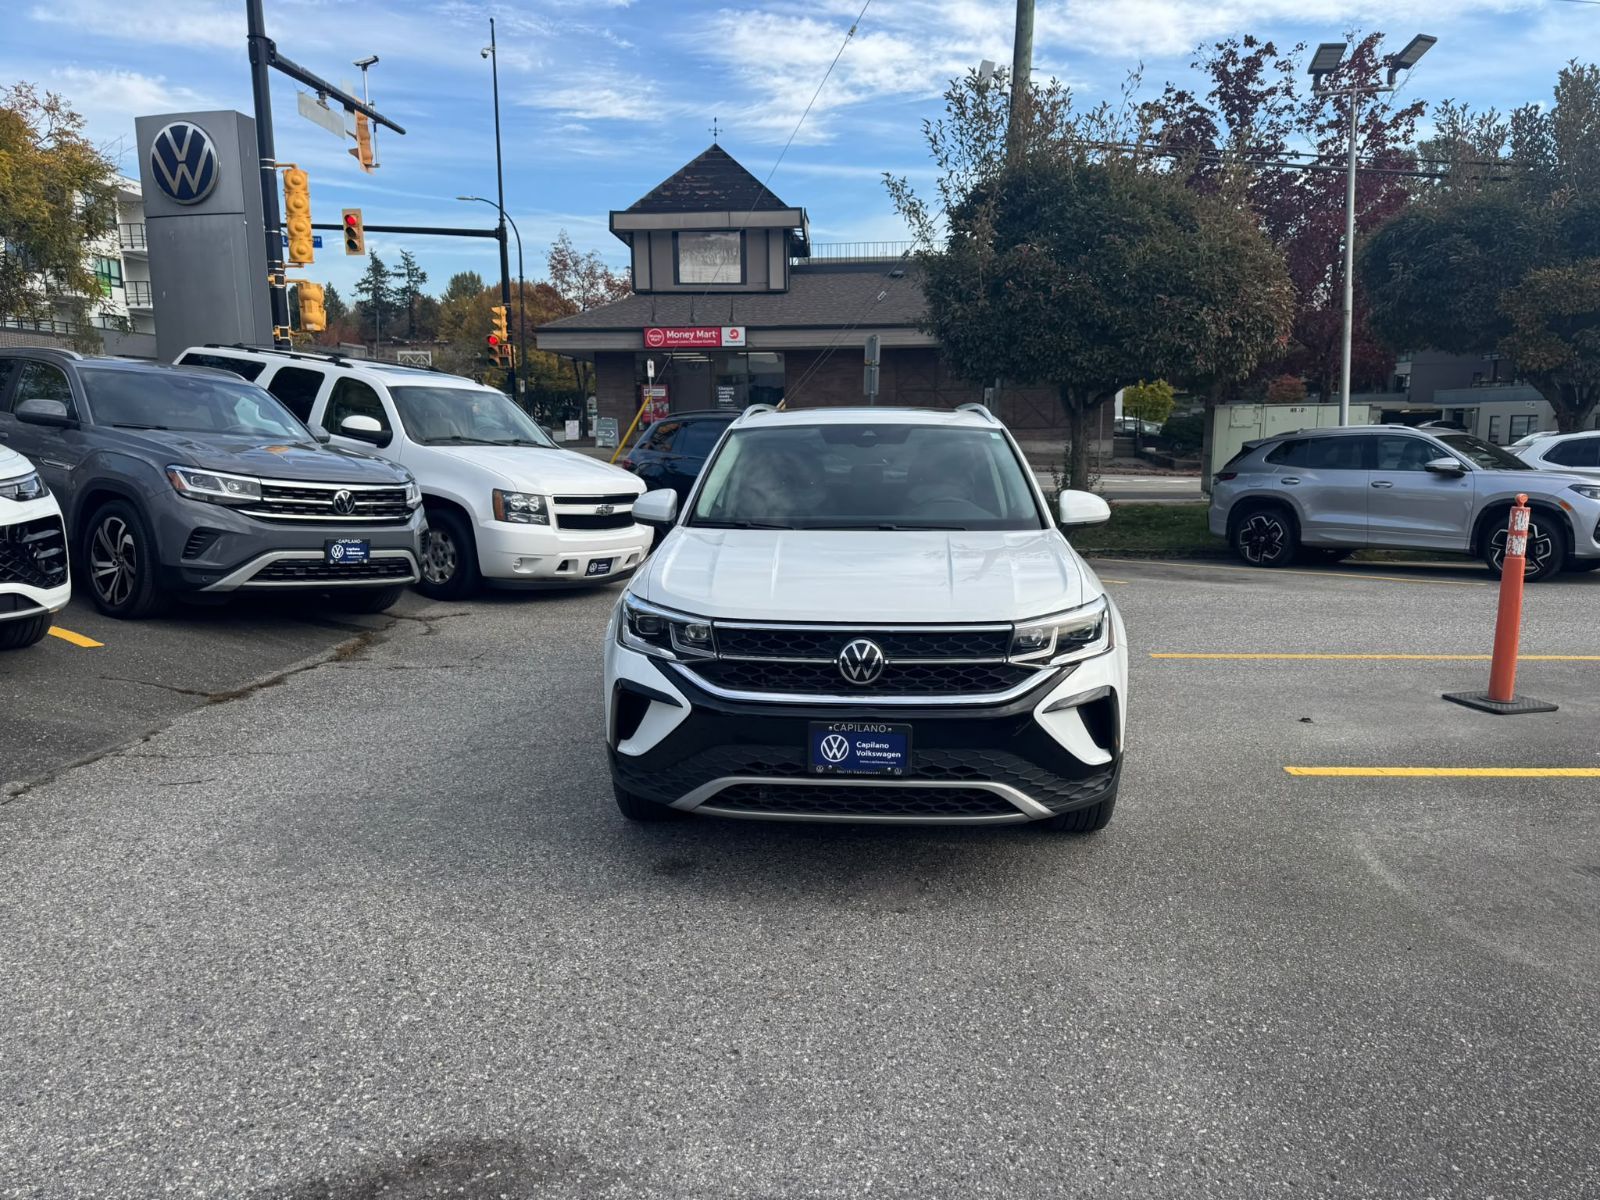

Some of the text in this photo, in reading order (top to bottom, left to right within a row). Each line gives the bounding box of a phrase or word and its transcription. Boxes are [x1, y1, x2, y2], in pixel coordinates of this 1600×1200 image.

[666, 330, 717, 340] Money Mart
[833, 723, 887, 733] CAPILANO
[856, 741, 889, 749] Capilano
[856, 750, 901, 759] Volkswagen
